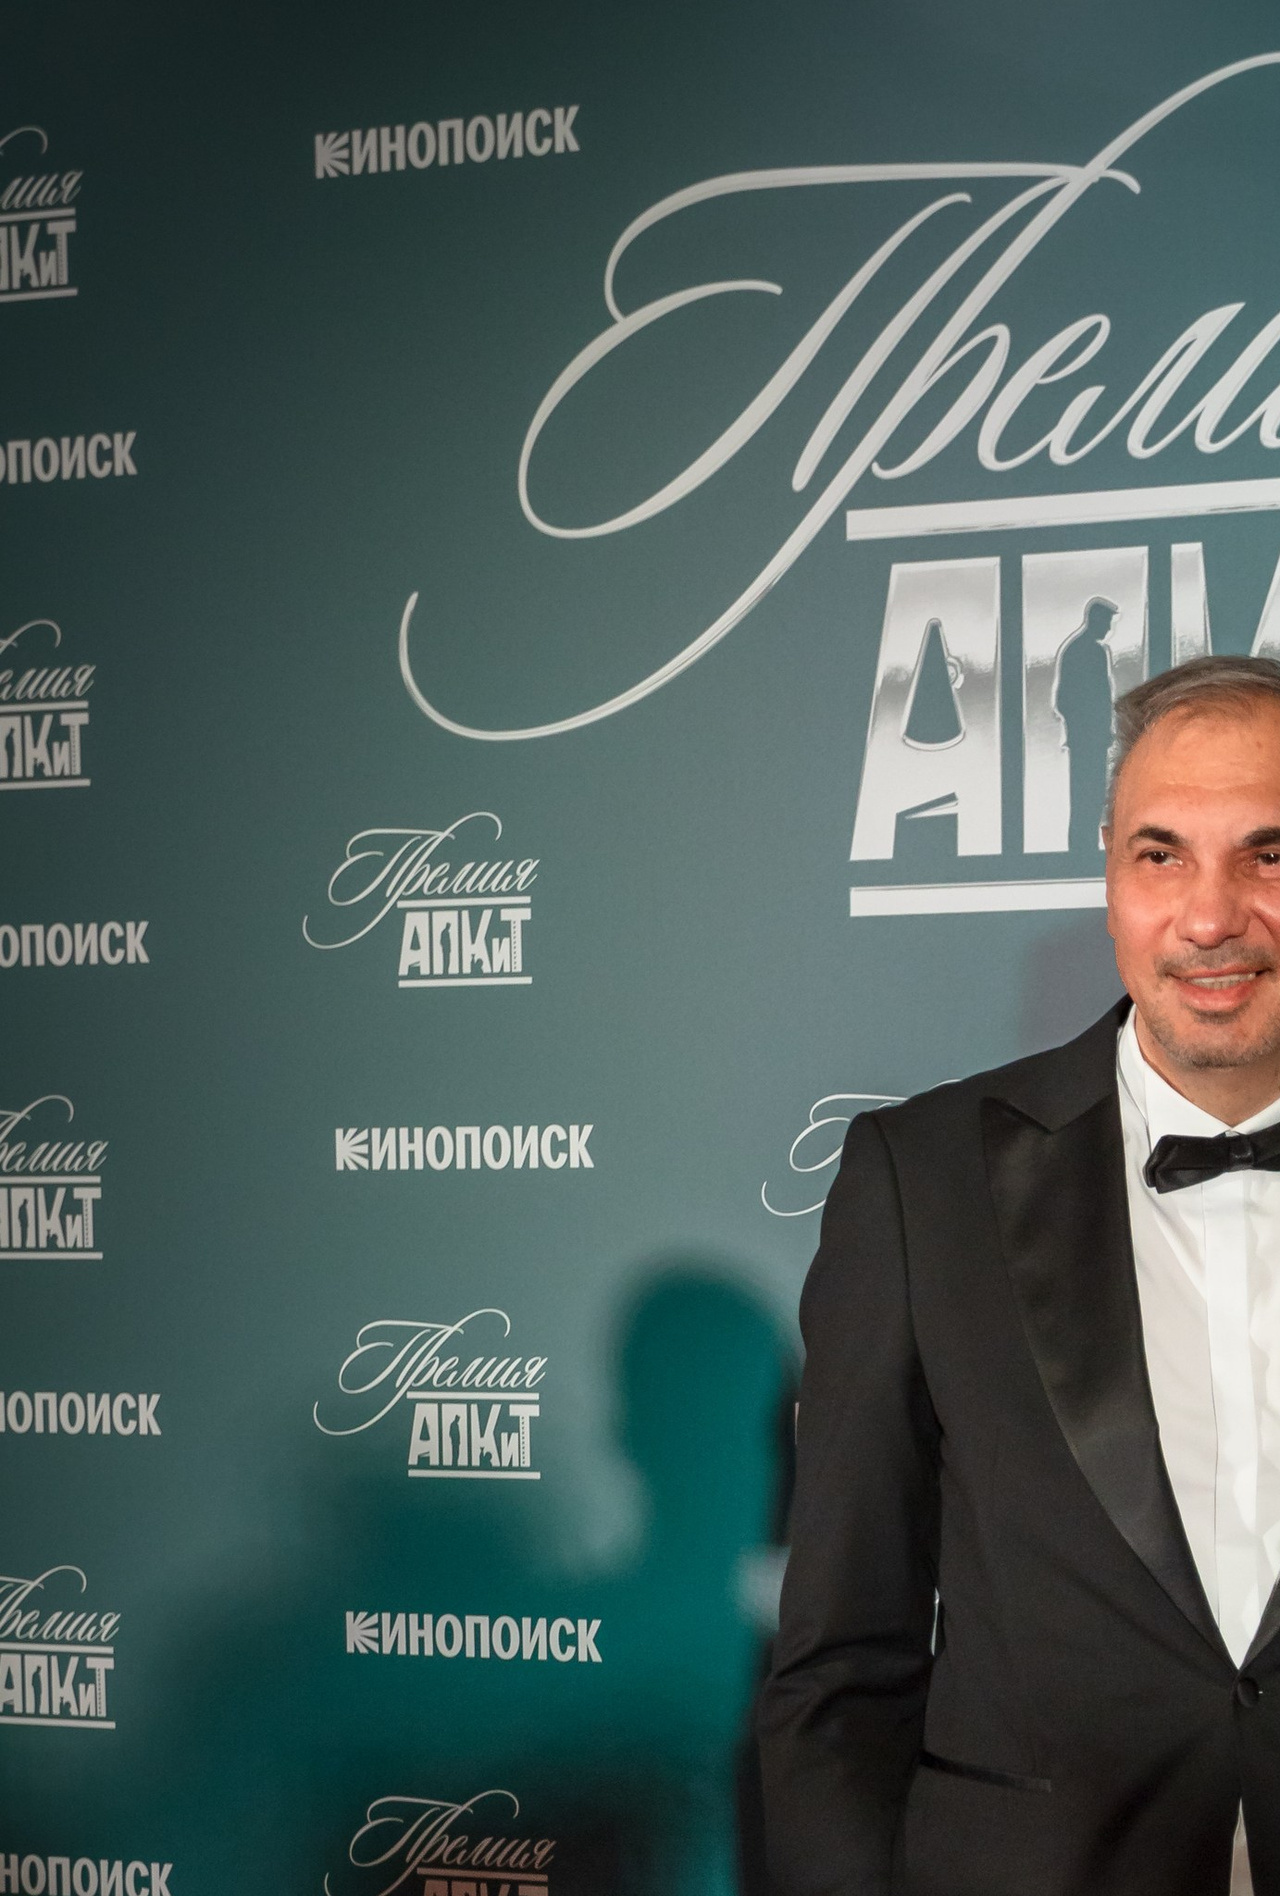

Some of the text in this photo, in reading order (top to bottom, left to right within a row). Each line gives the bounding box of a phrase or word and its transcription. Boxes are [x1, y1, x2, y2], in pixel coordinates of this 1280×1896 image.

[314, 104, 582, 180] КИНОПОИСК
[0, 218, 78, 291] КиТ
[0, 430, 138, 485] ПОИСК
[0, 711, 90, 780] ПКиТ
[302, 811, 541, 950] Премия
[0, 920, 152, 969] ОПОИСК
[334, 1122, 596, 1173] КИНОПОИСК
[0, 1186, 103, 1249] ПКиТ
[313, 1307, 549, 1436] Премия
[0, 1390, 164, 1437] ОПОИСК
[345, 1610, 605, 1664] КИНОПОИСК
